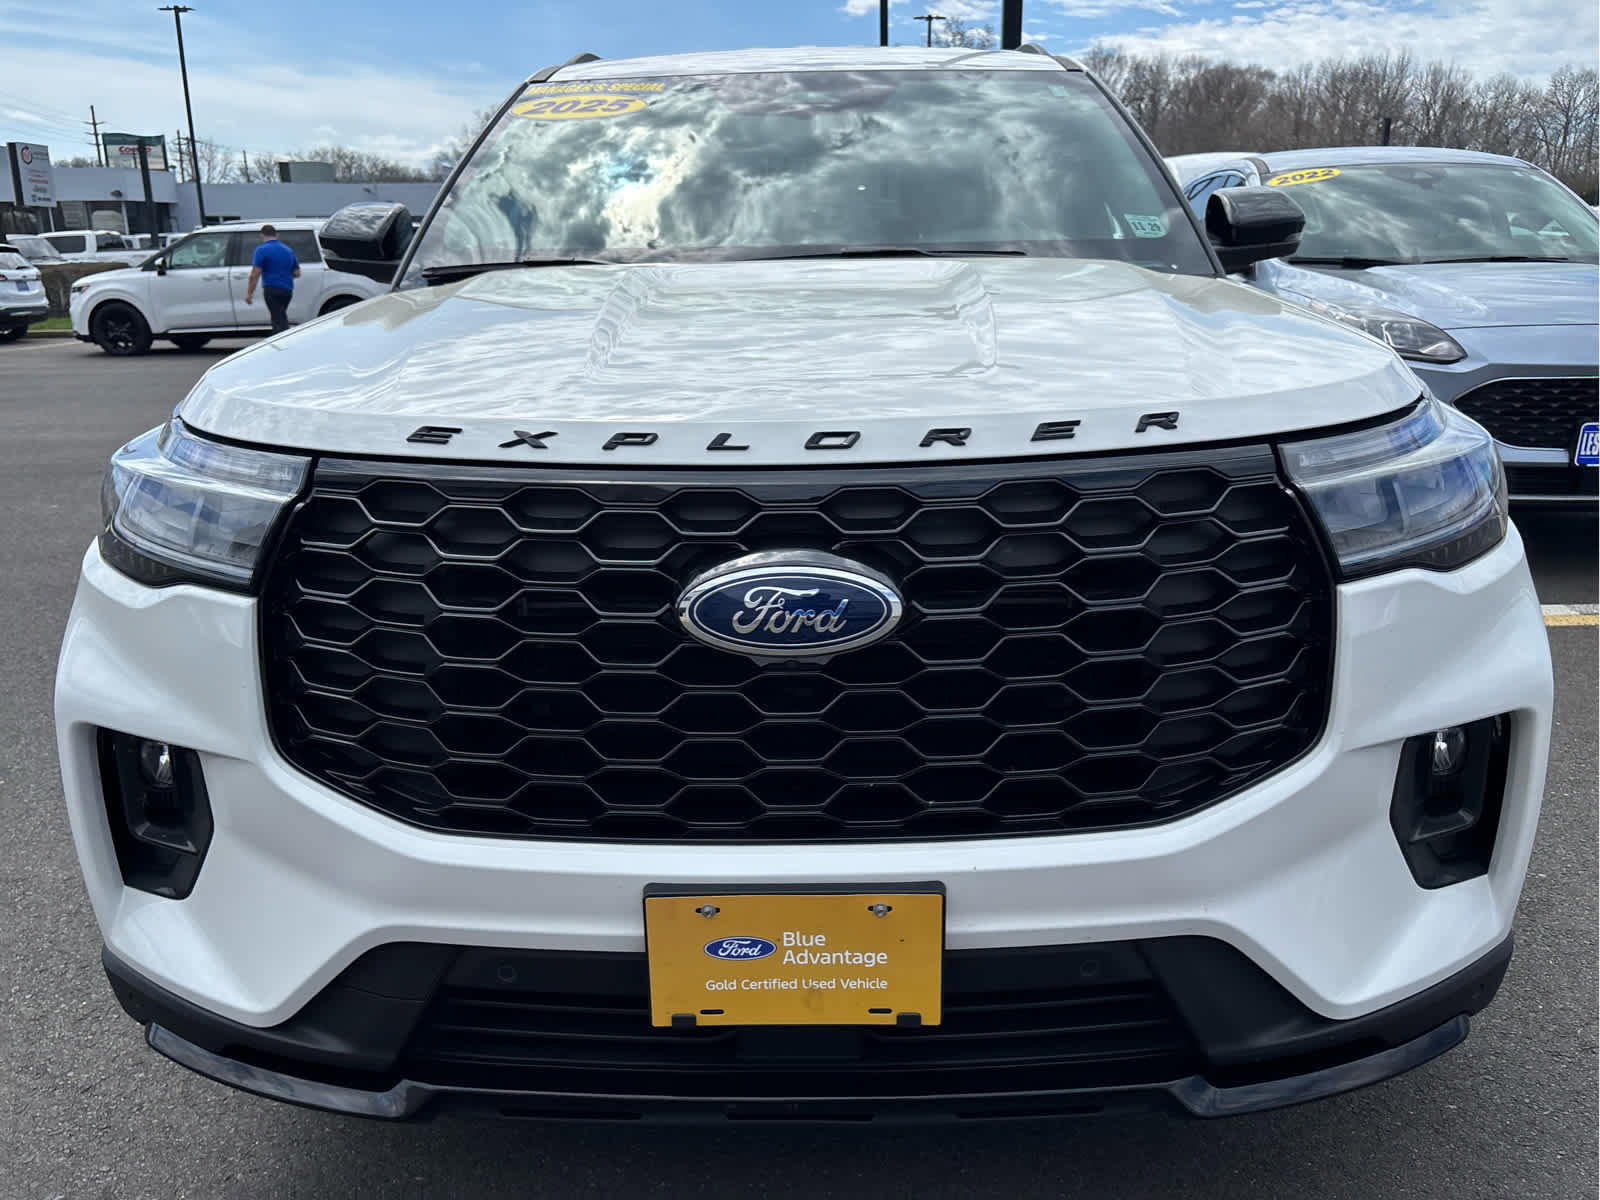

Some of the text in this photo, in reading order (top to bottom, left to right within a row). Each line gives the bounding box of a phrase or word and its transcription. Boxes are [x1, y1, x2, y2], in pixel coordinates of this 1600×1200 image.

[525, 82, 665, 95] MANAGER'S SPECIAL
[520, 99, 637, 115] 2025
[1276, 169, 1334, 185] 2022
[405, 411, 1179, 452] EXPLORER
[732, 593, 849, 634] Ford
[782, 931, 827, 947] Blue
[718, 940, 763, 957] Ford
[782, 949, 888, 967] Advantage
[705, 977, 888, 991] Gold Certified Used Vehicle
